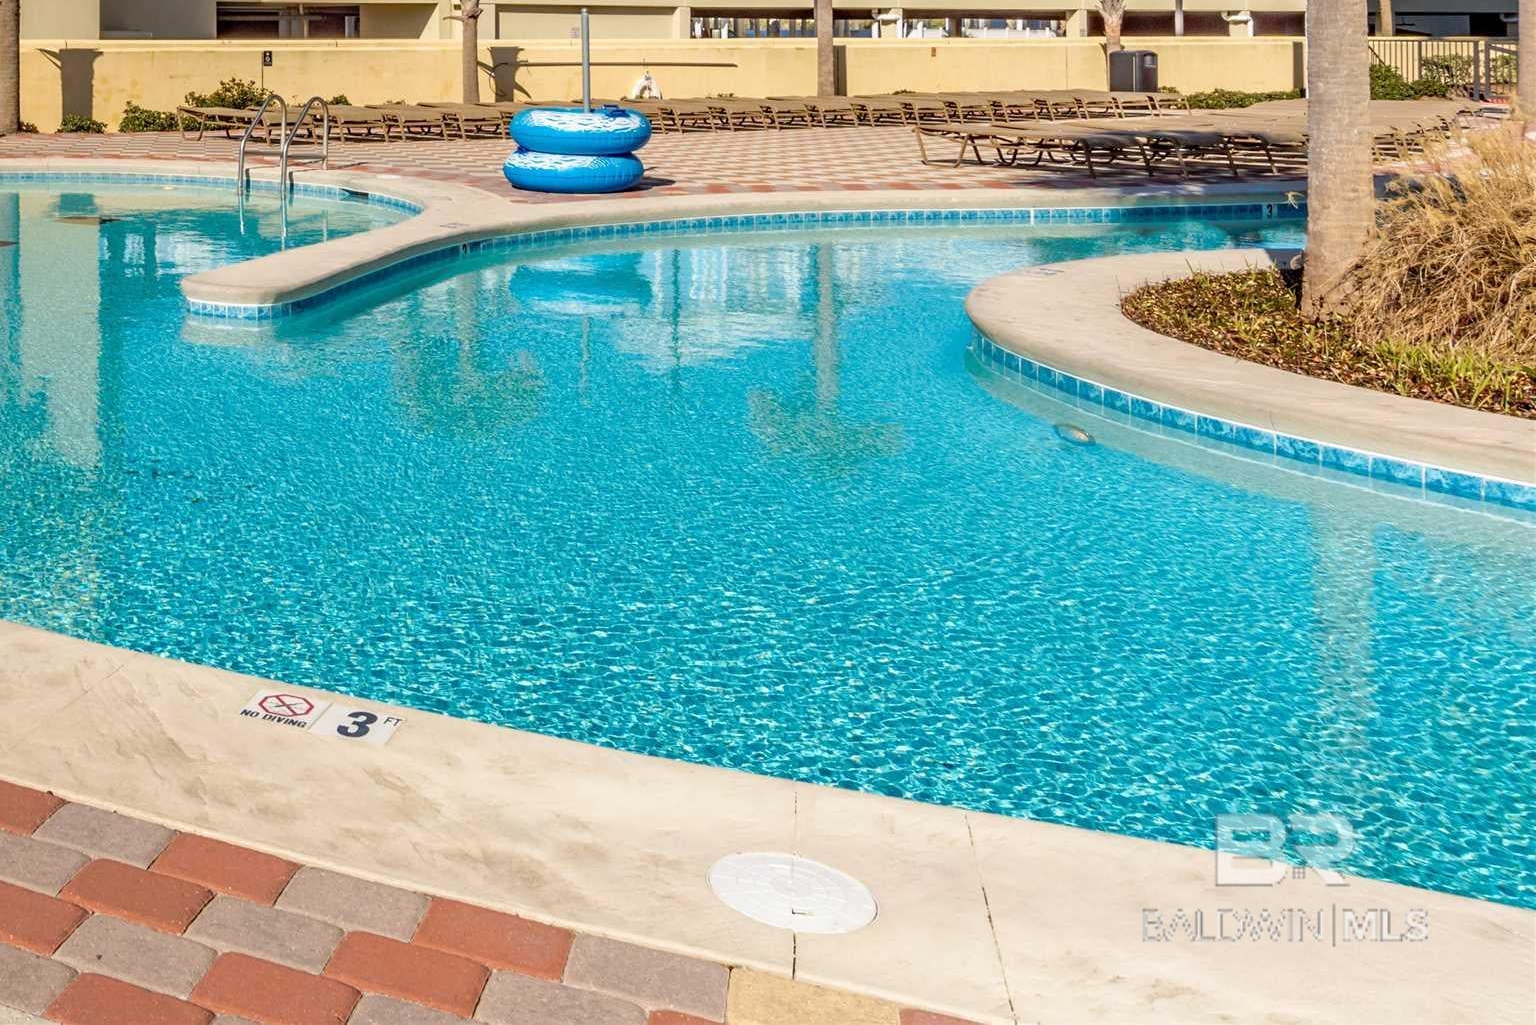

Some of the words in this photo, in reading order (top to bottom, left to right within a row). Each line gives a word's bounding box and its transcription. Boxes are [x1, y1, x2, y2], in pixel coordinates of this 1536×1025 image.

[239, 708, 259, 718] NO
[262, 715, 307, 729] DIVING
[336, 711, 379, 738] 3
[383, 716, 403, 727] FT
